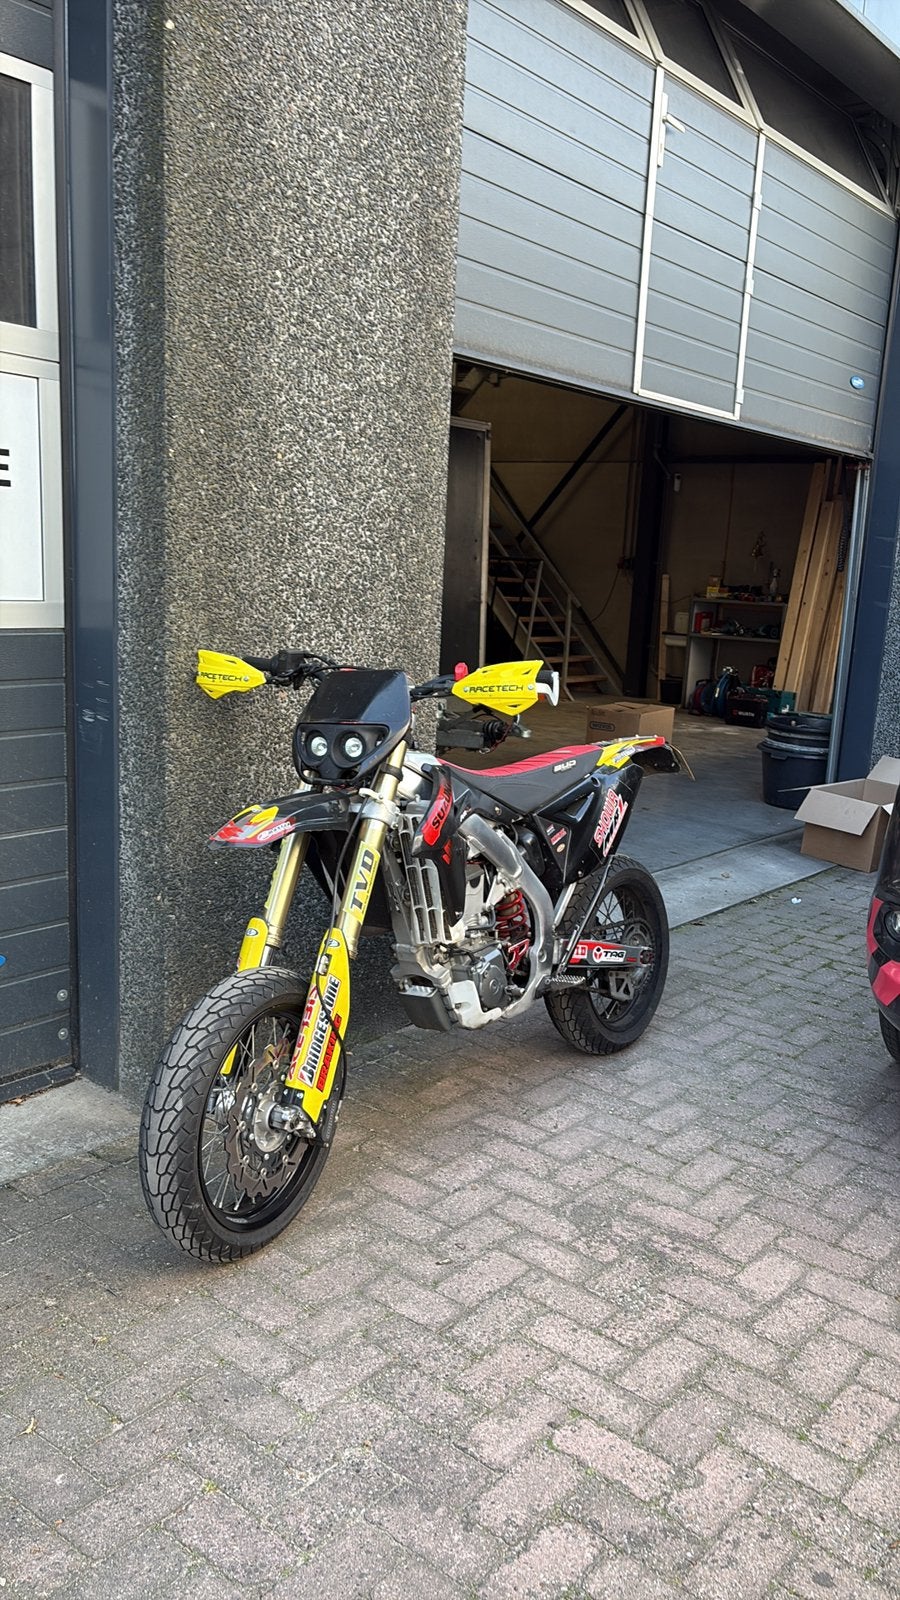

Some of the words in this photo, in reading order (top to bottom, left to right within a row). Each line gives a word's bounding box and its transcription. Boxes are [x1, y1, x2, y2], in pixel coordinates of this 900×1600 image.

[200, 671, 242, 682] RACETECH
[469, 684, 524, 693] RACETECH
[593, 788, 621, 849] SHOWA
[350, 849, 374, 909] TVD
[603, 950, 625, 958] TAG
[300, 976, 340, 1085] BRIDGESONE
